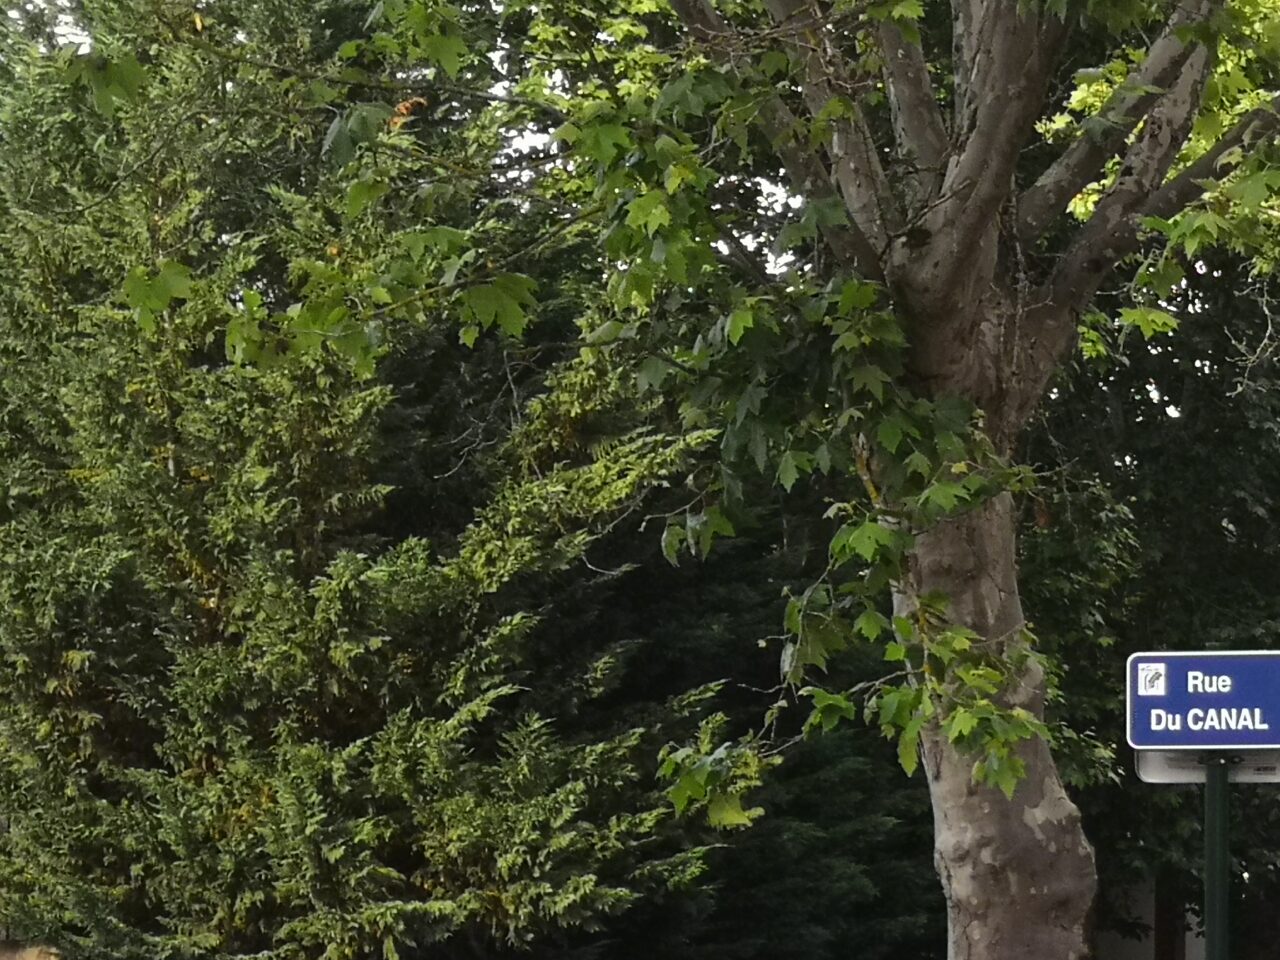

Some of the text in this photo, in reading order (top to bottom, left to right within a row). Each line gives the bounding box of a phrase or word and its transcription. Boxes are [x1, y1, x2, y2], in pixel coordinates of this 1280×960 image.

[1187, 671, 1232, 693] Rue
[1150, 708, 1269, 730] Du CANAL
